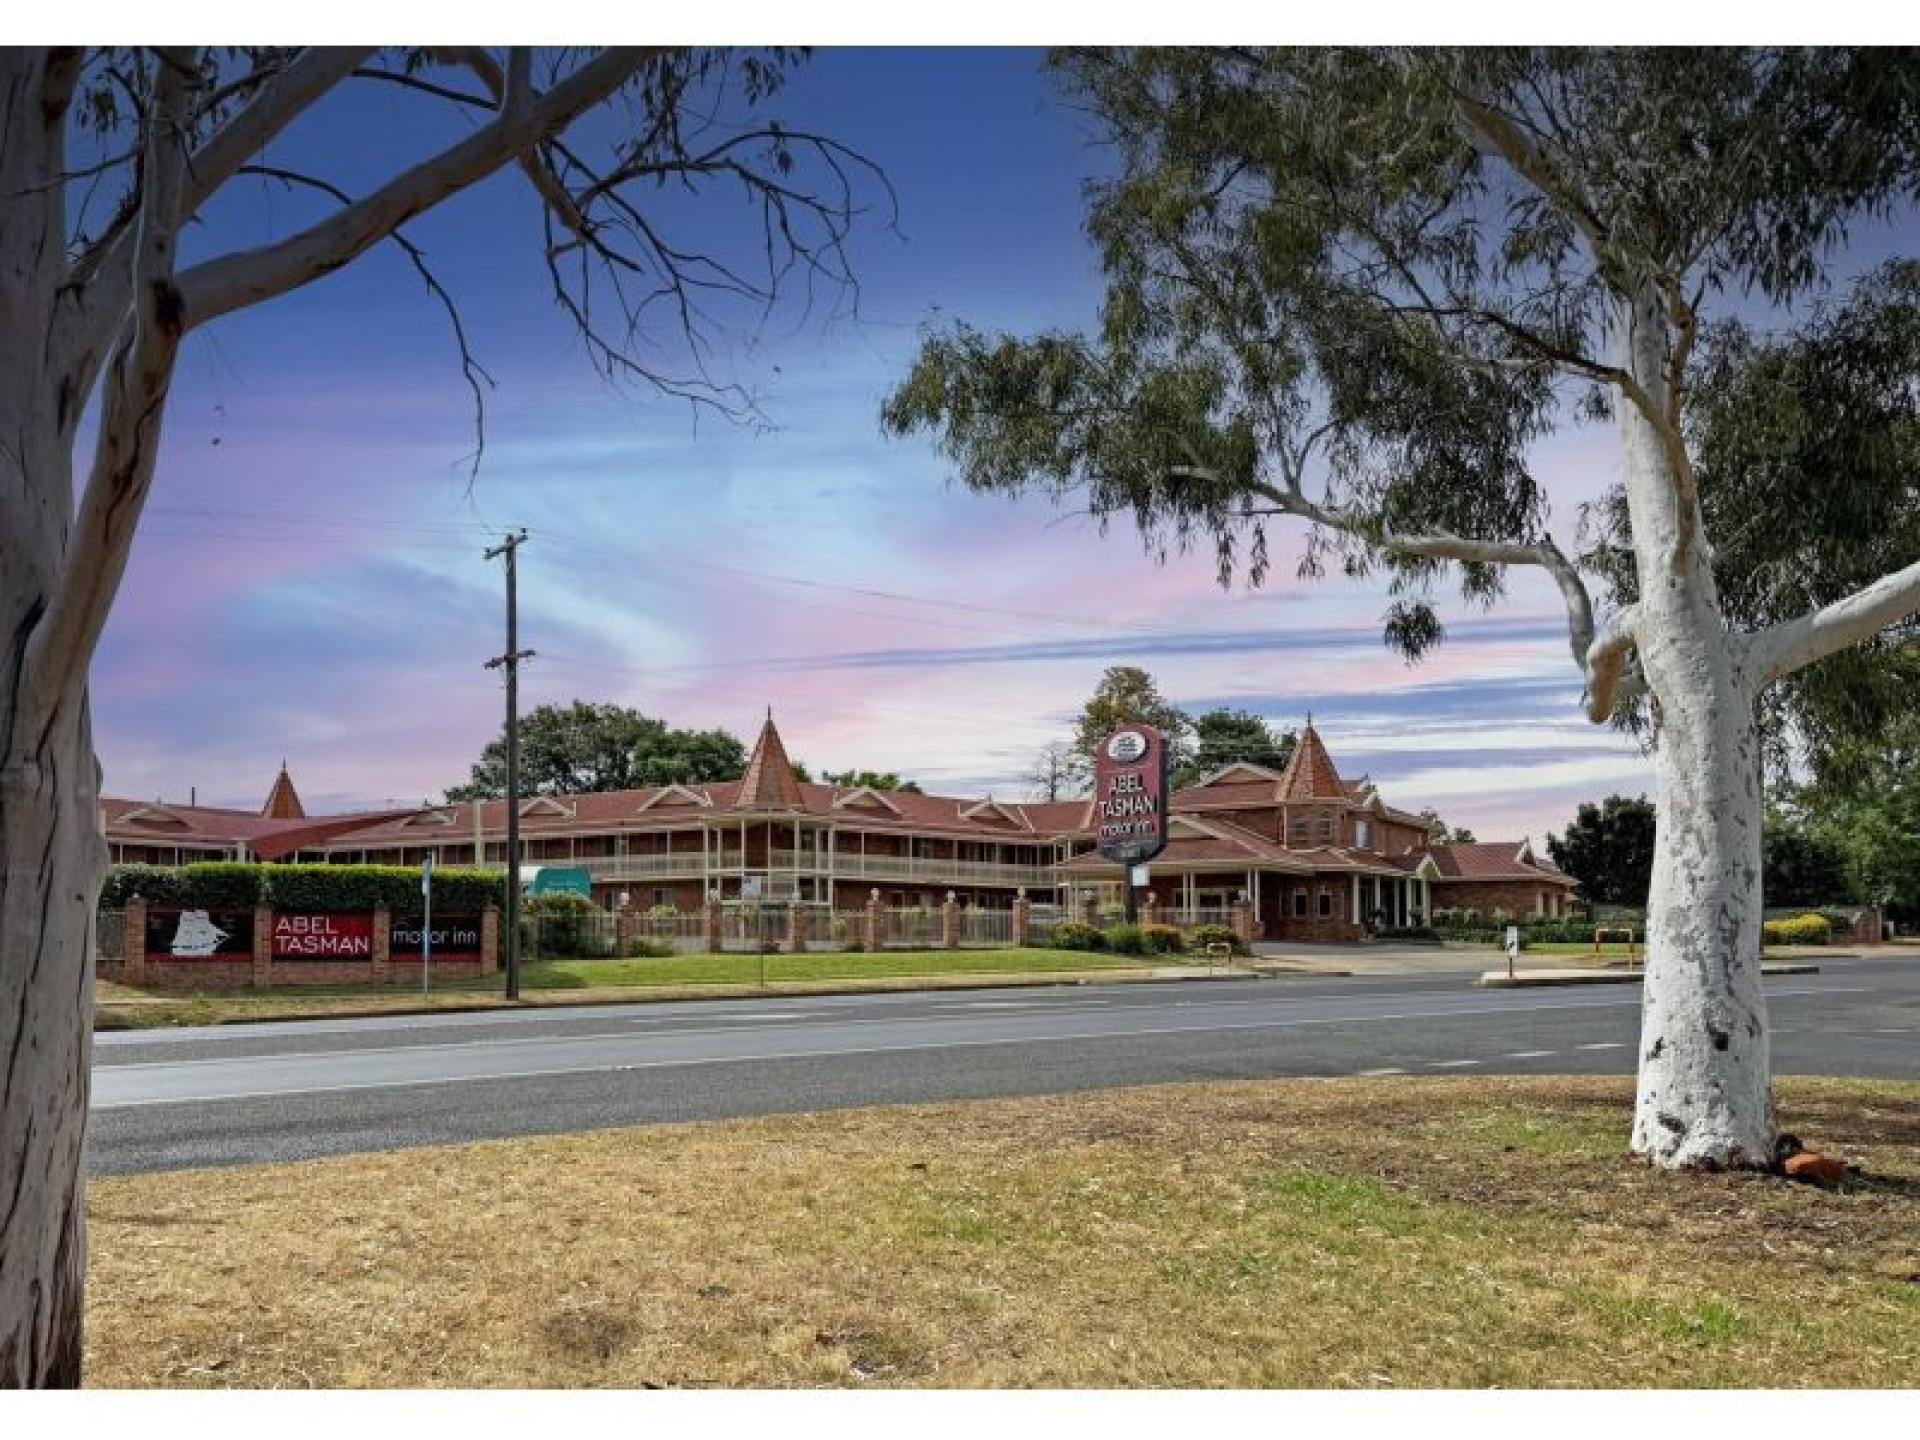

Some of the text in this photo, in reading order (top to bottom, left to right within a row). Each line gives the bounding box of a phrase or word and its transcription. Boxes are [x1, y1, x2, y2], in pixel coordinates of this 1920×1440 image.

[1098, 796, 1154, 819] TASMAN
[275, 916, 339, 934] ABEL
[453, 926, 476, 944] inn
[275, 935, 368, 954] TASMAN
